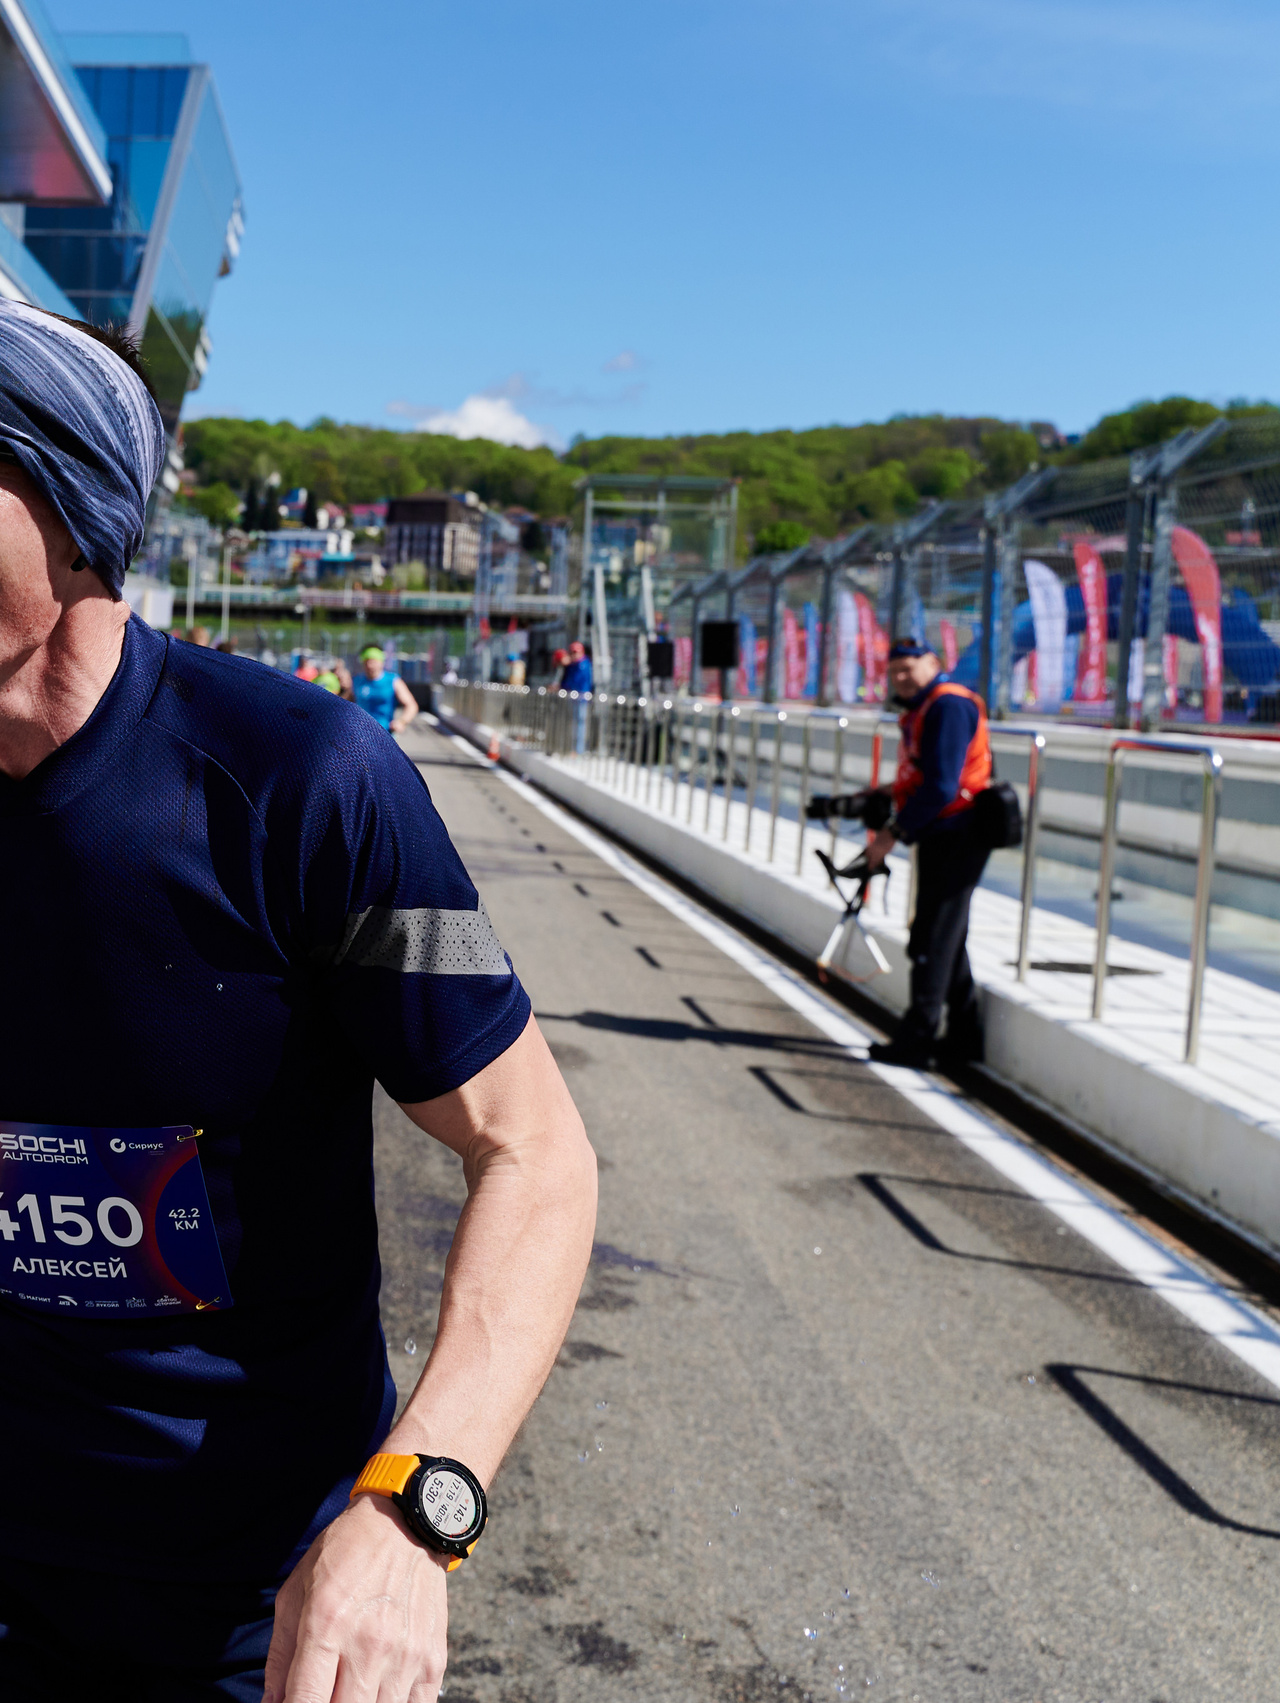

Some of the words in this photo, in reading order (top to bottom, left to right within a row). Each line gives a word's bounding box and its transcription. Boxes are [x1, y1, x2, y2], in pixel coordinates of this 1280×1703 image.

[128, 1142, 164, 1151] Сириус
[2, 1151, 89, 1165] AUTODROM
[168, 1207, 201, 1219] 42.2
[12, 1256, 128, 1279] АЛЕКСЕЙ
[425, 1477, 444, 1503] 5:30
[445, 1478, 461, 1501] 17.19
[453, 1503, 468, 1523] 143
